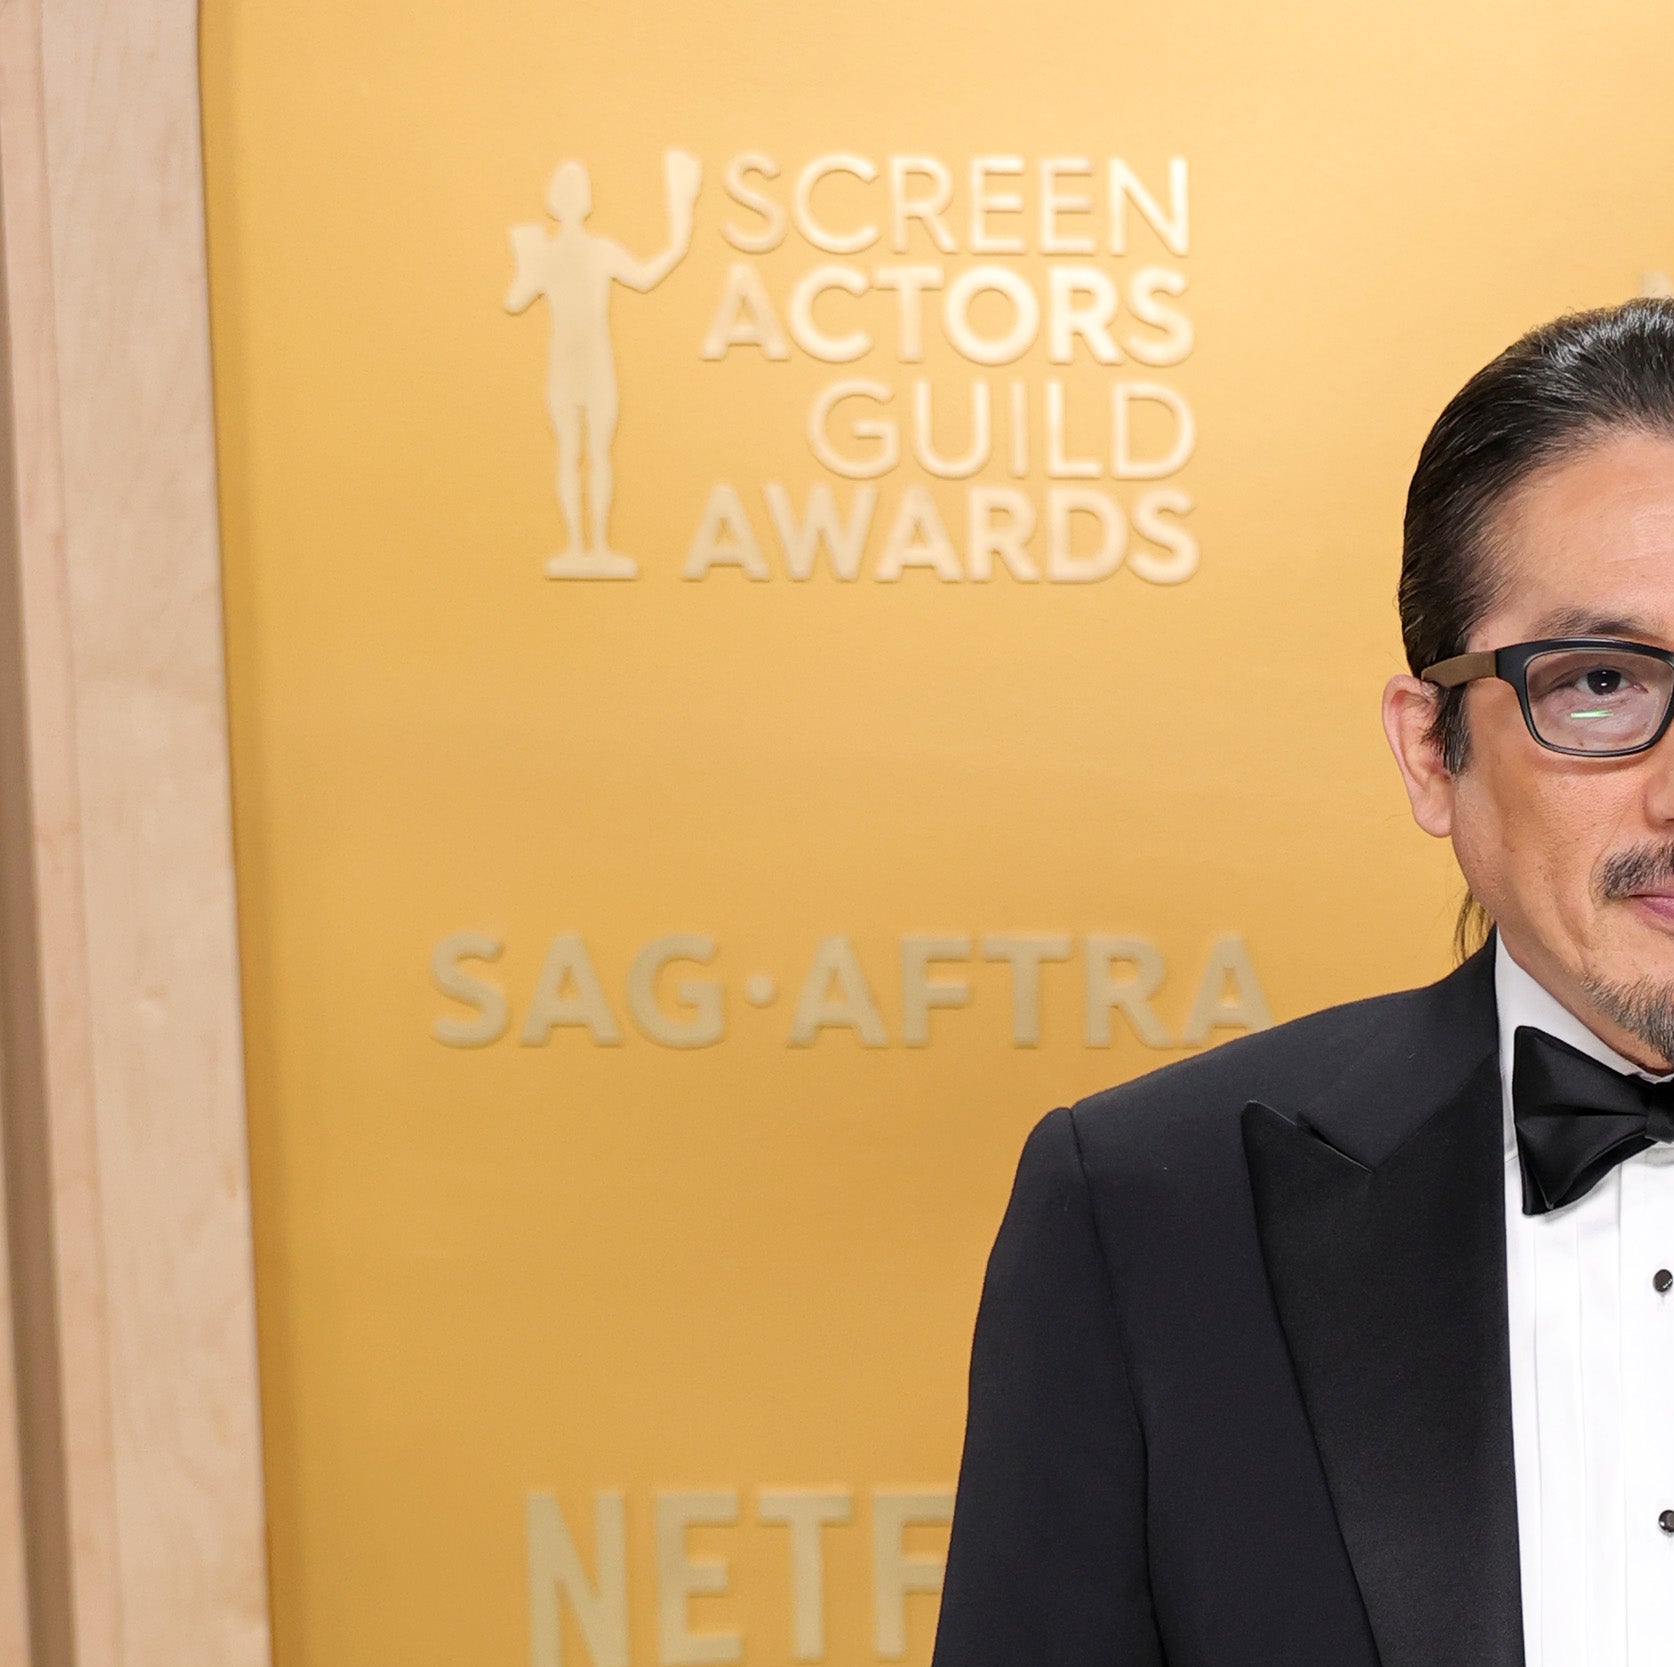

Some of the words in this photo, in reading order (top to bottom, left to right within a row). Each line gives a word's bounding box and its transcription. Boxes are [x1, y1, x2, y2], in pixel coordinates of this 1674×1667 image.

[721, 152, 1190, 257] SCREEN
[700, 265, 1196, 367] ACTORS
[806, 378, 1197, 481] GUILD
[681, 482, 1201, 587] AWARDS
